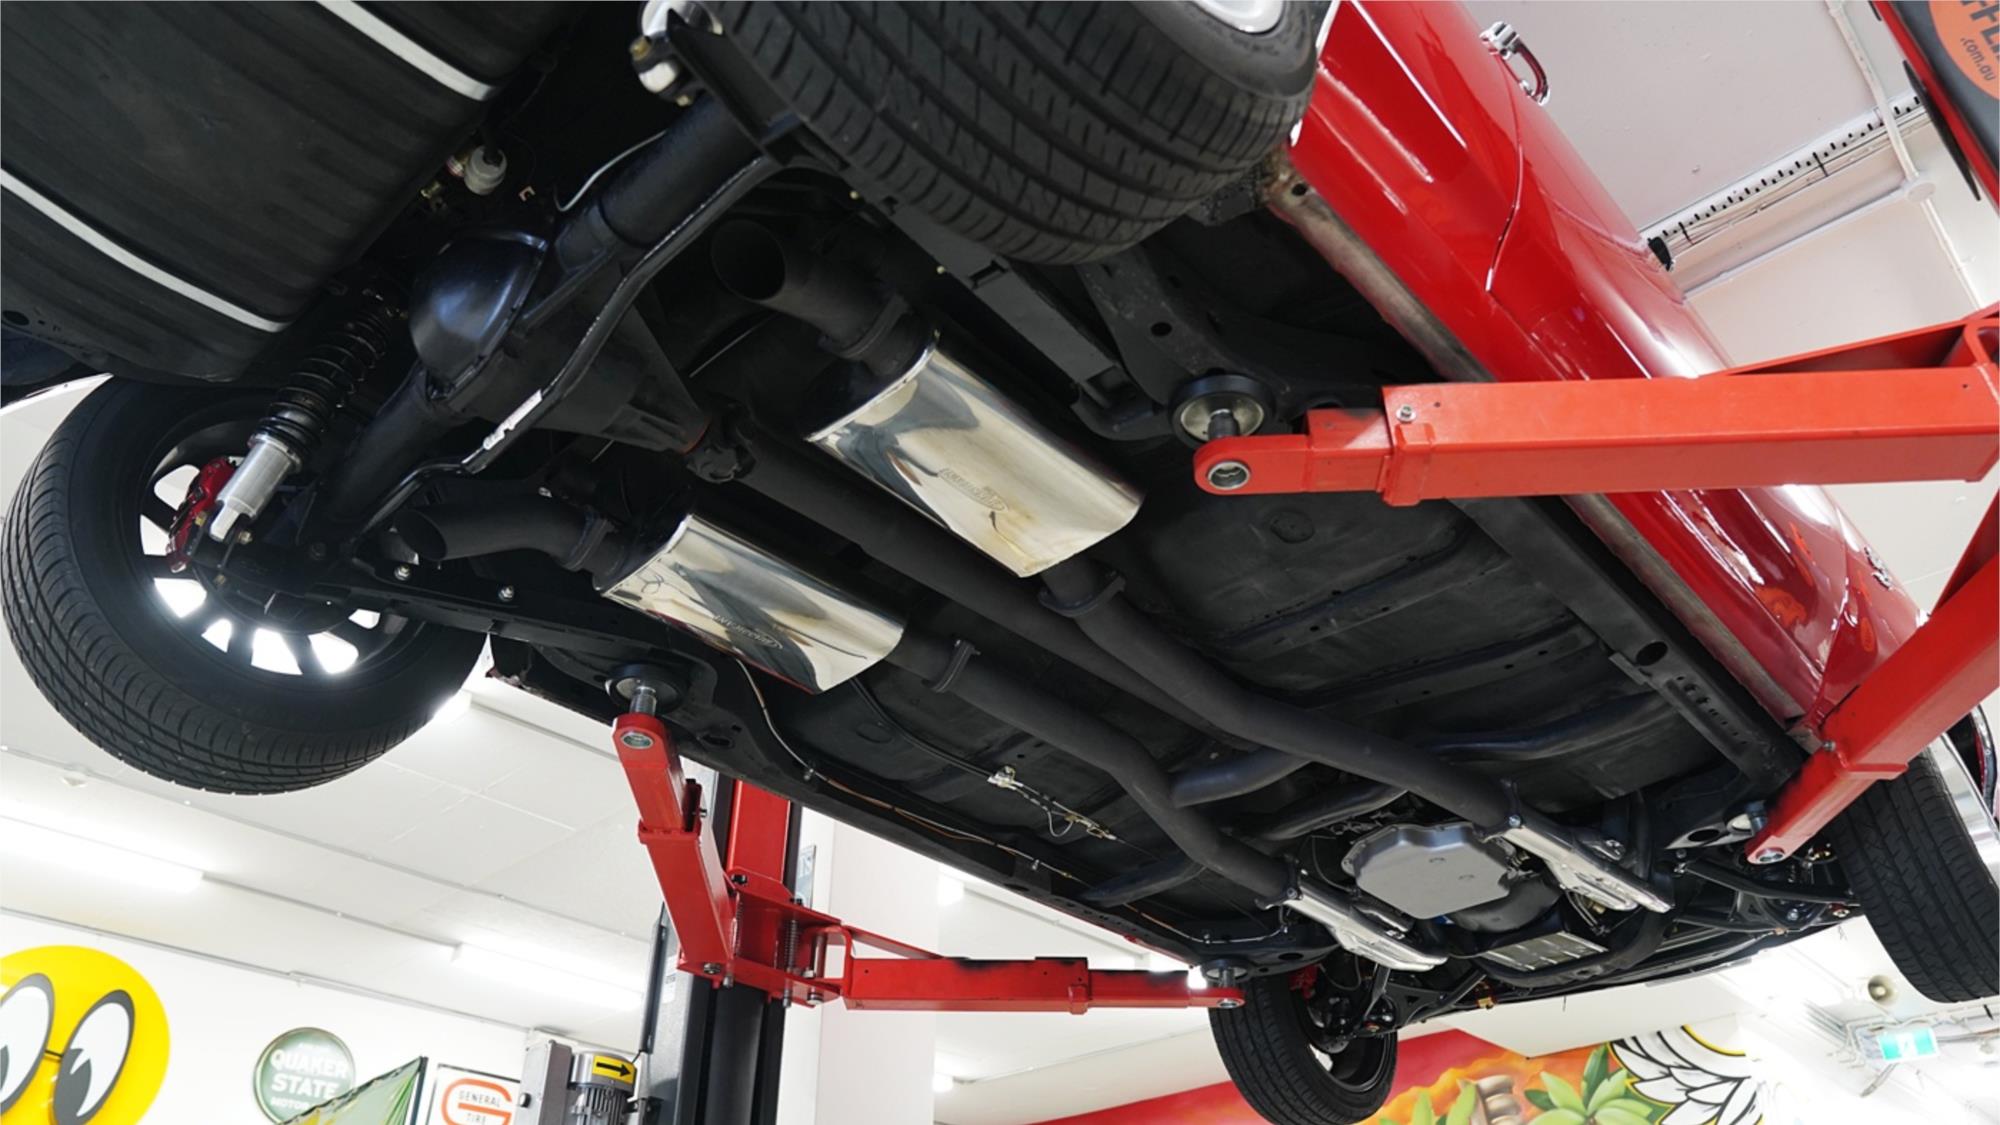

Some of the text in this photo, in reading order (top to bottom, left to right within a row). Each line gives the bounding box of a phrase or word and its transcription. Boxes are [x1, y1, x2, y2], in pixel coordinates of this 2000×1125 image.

[271, 1049, 349, 1079] QUAKER
[271, 1073, 339, 1100] STATE
[458, 1089, 501, 1108] GENERAL
